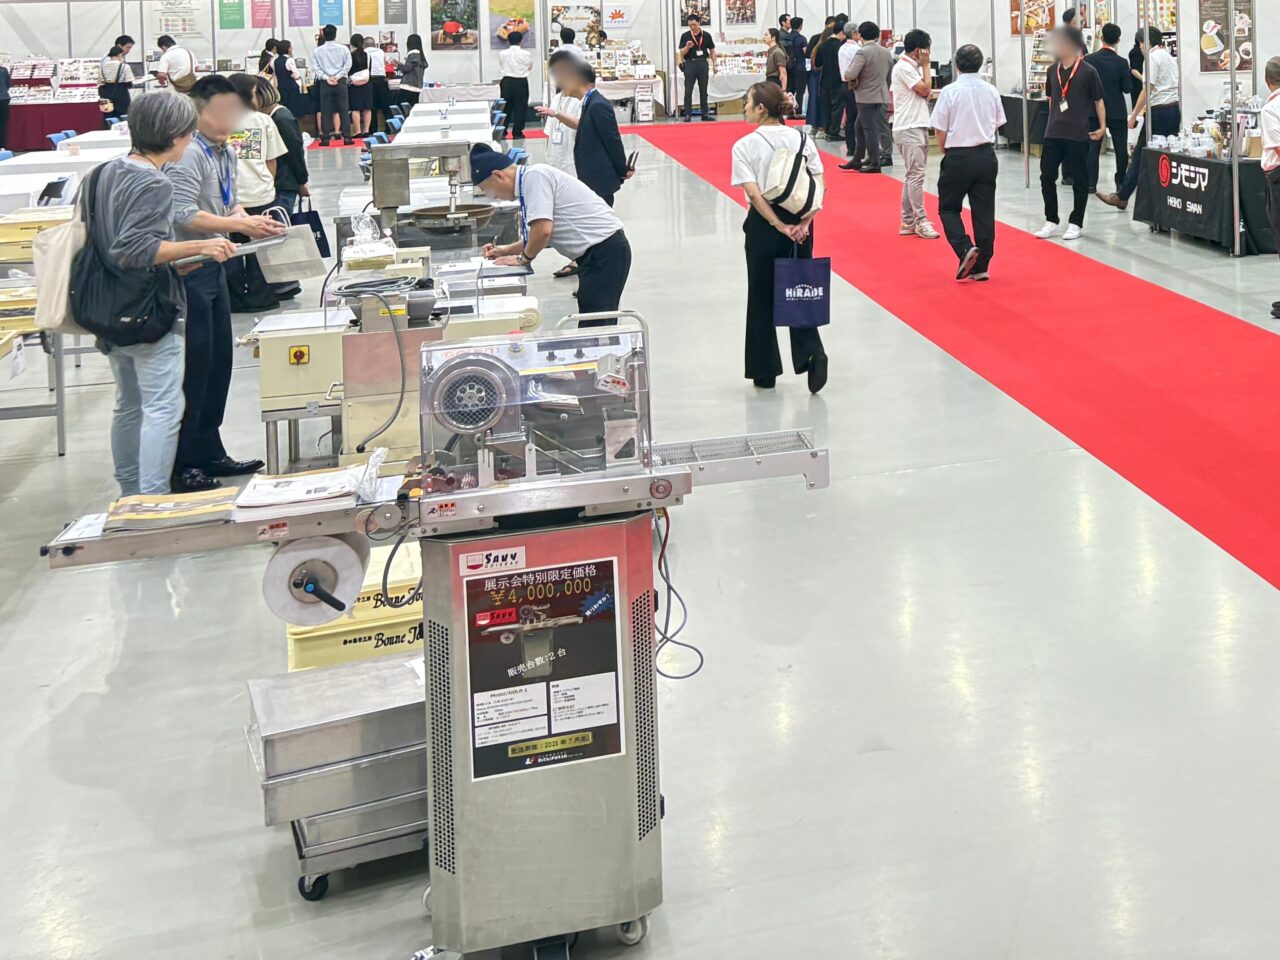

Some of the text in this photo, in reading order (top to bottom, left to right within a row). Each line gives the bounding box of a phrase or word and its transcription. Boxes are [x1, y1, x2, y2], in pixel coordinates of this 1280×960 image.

[1171, 161, 1209, 191] シモジマ
[1186, 202, 1202, 214] SWAN
[484, 564, 597, 591] 展示会特別限定価格
[374, 632, 406, 649] Bonne
